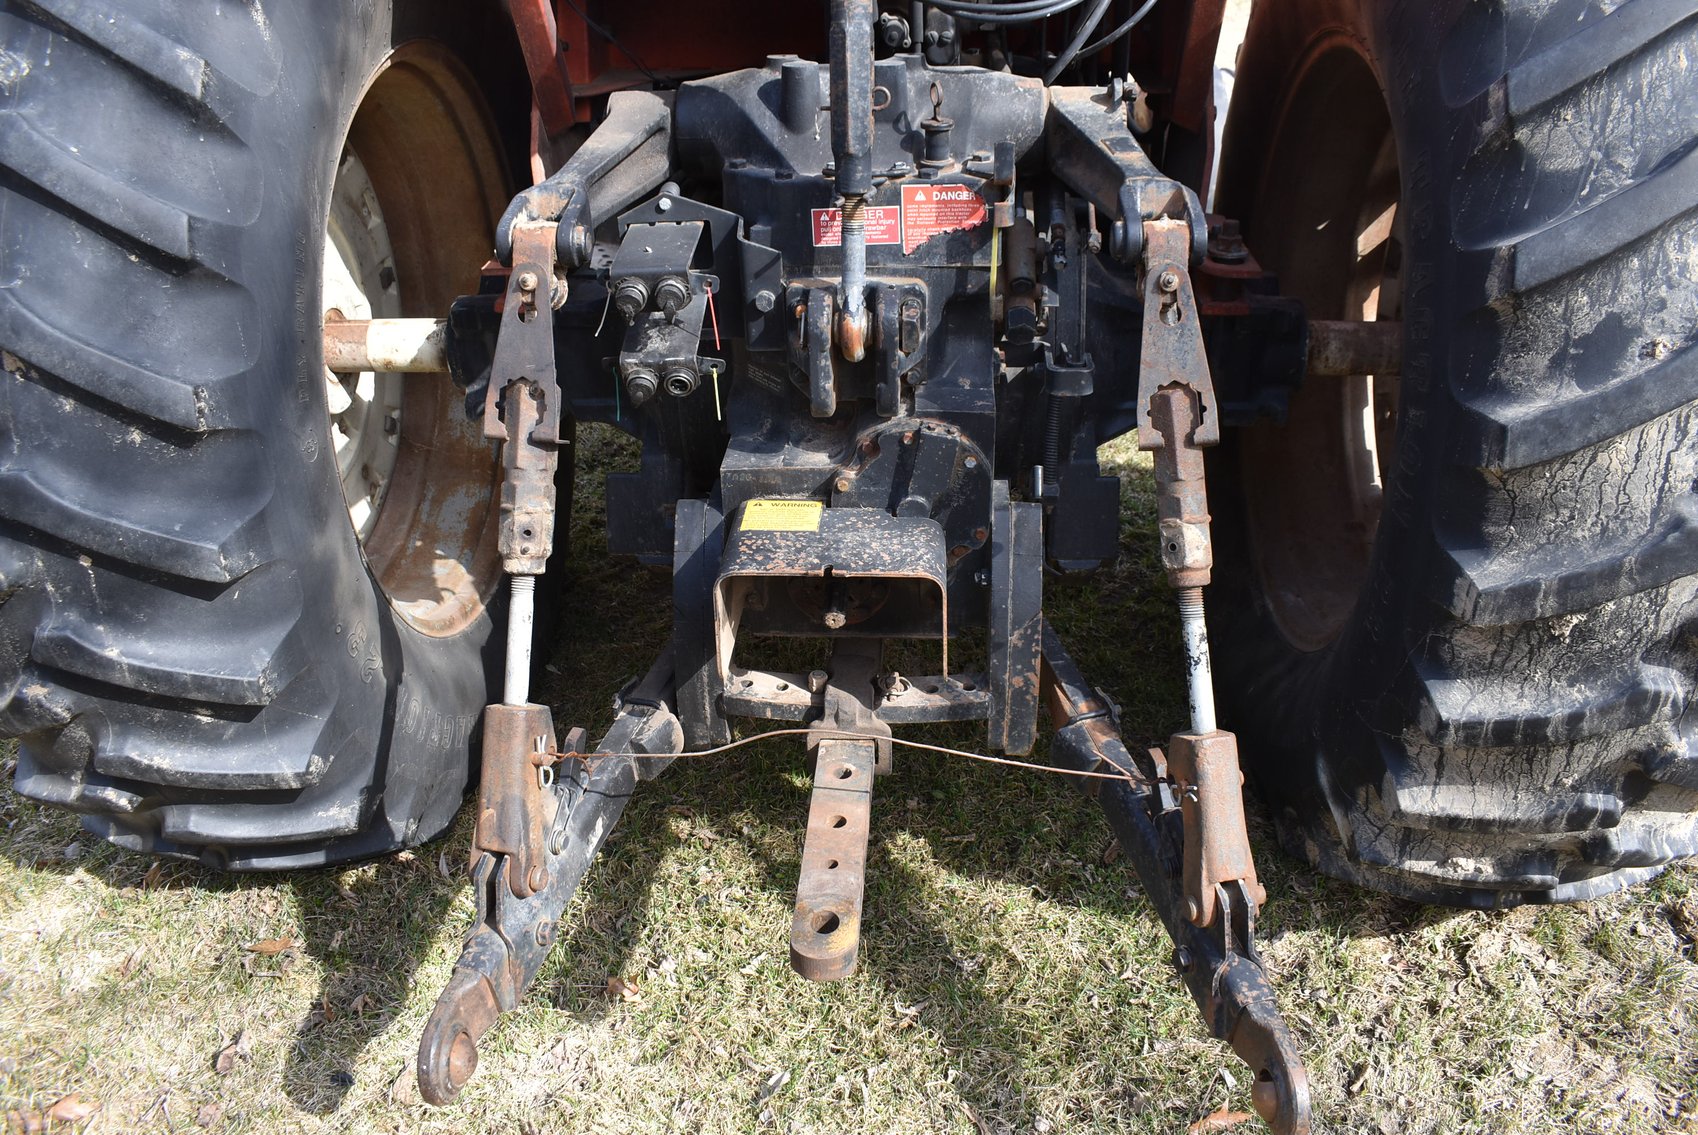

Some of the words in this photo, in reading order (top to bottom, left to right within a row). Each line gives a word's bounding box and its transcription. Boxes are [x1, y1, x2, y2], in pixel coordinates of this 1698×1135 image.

[932, 191, 976, 200] DANGER
[835, 210, 884, 220] DGER
[878, 218, 895, 226] injury
